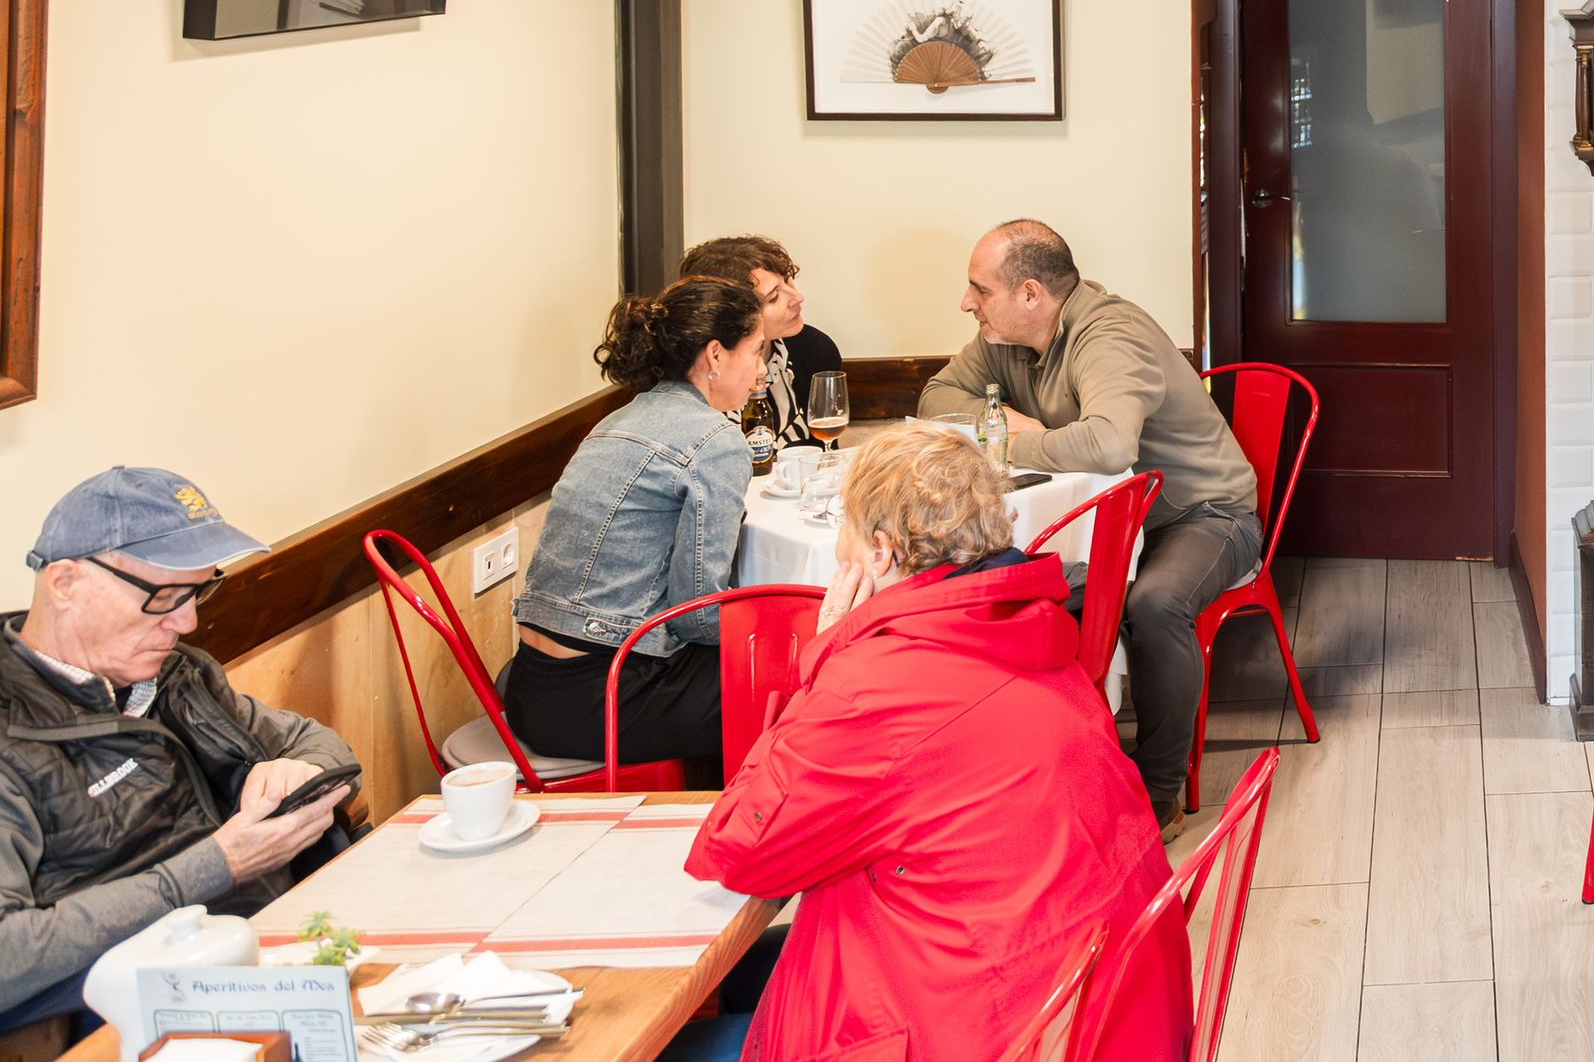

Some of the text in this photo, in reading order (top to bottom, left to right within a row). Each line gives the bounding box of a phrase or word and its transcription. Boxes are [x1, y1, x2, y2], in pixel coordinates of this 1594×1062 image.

[191, 978, 336, 994] Aperitivos del Mes
